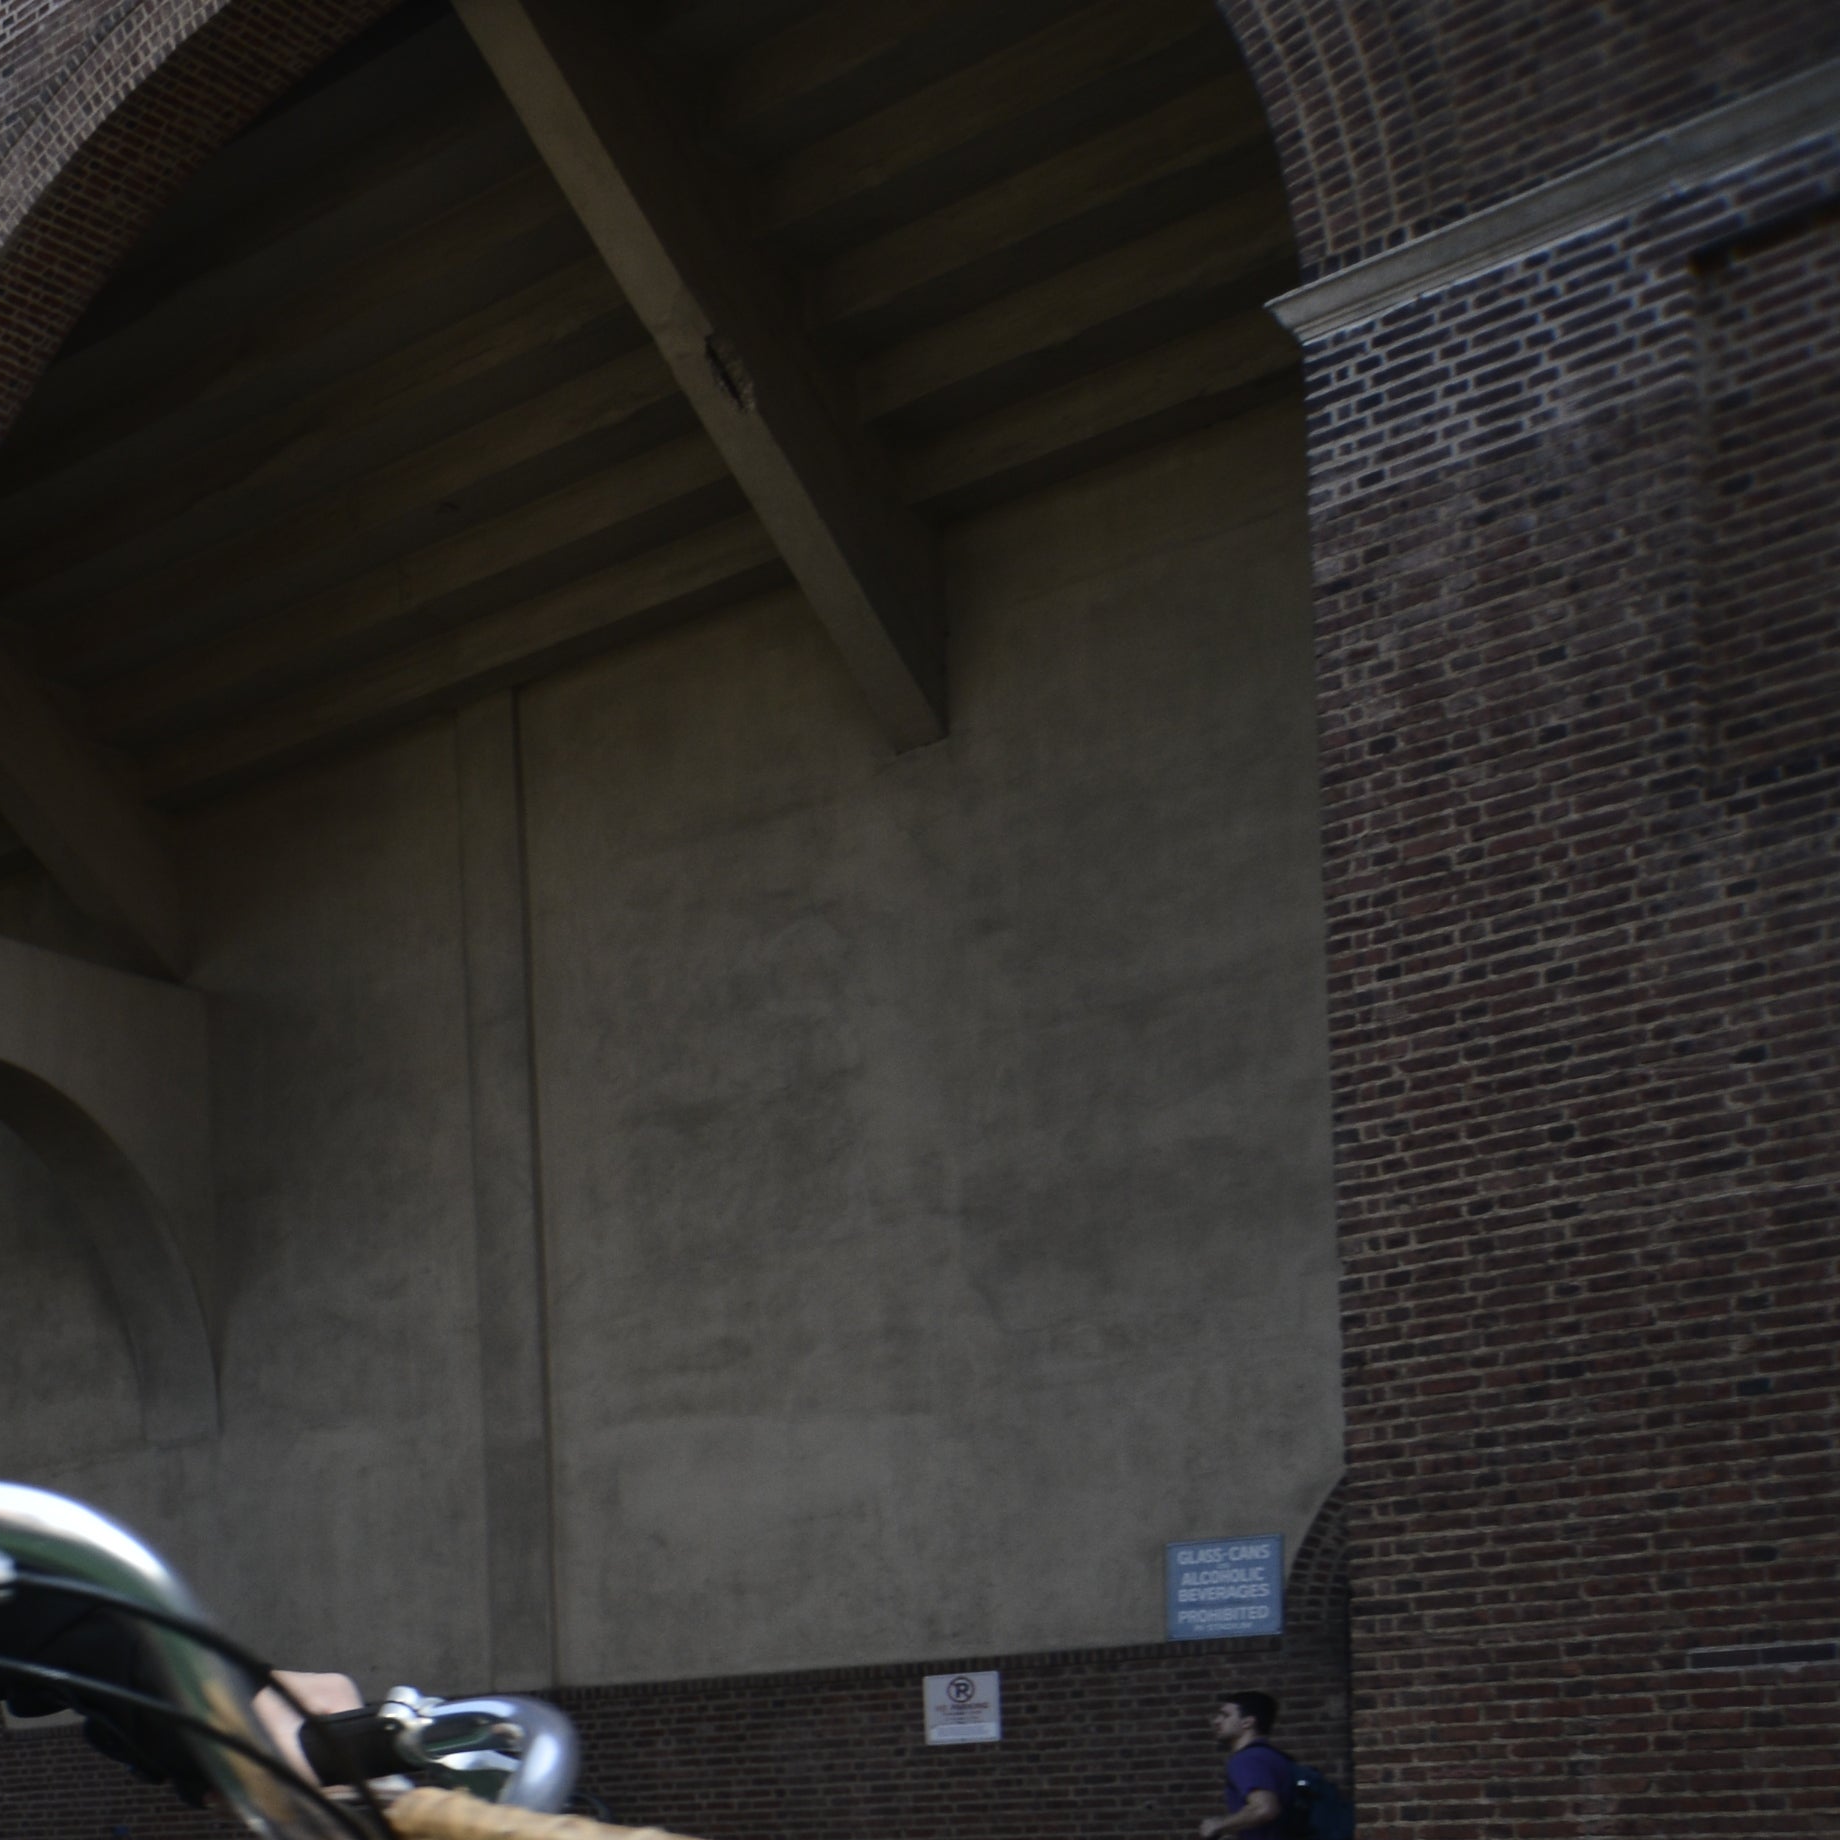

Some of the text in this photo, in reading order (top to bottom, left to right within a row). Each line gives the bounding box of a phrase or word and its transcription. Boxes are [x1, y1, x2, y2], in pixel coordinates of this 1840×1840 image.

[1181, 1566, 1265, 1586] ALCOHOLIC
[1178, 1583, 1270, 1602] BEVERAGES
[1178, 1605, 1269, 1623] PROHIBITED
